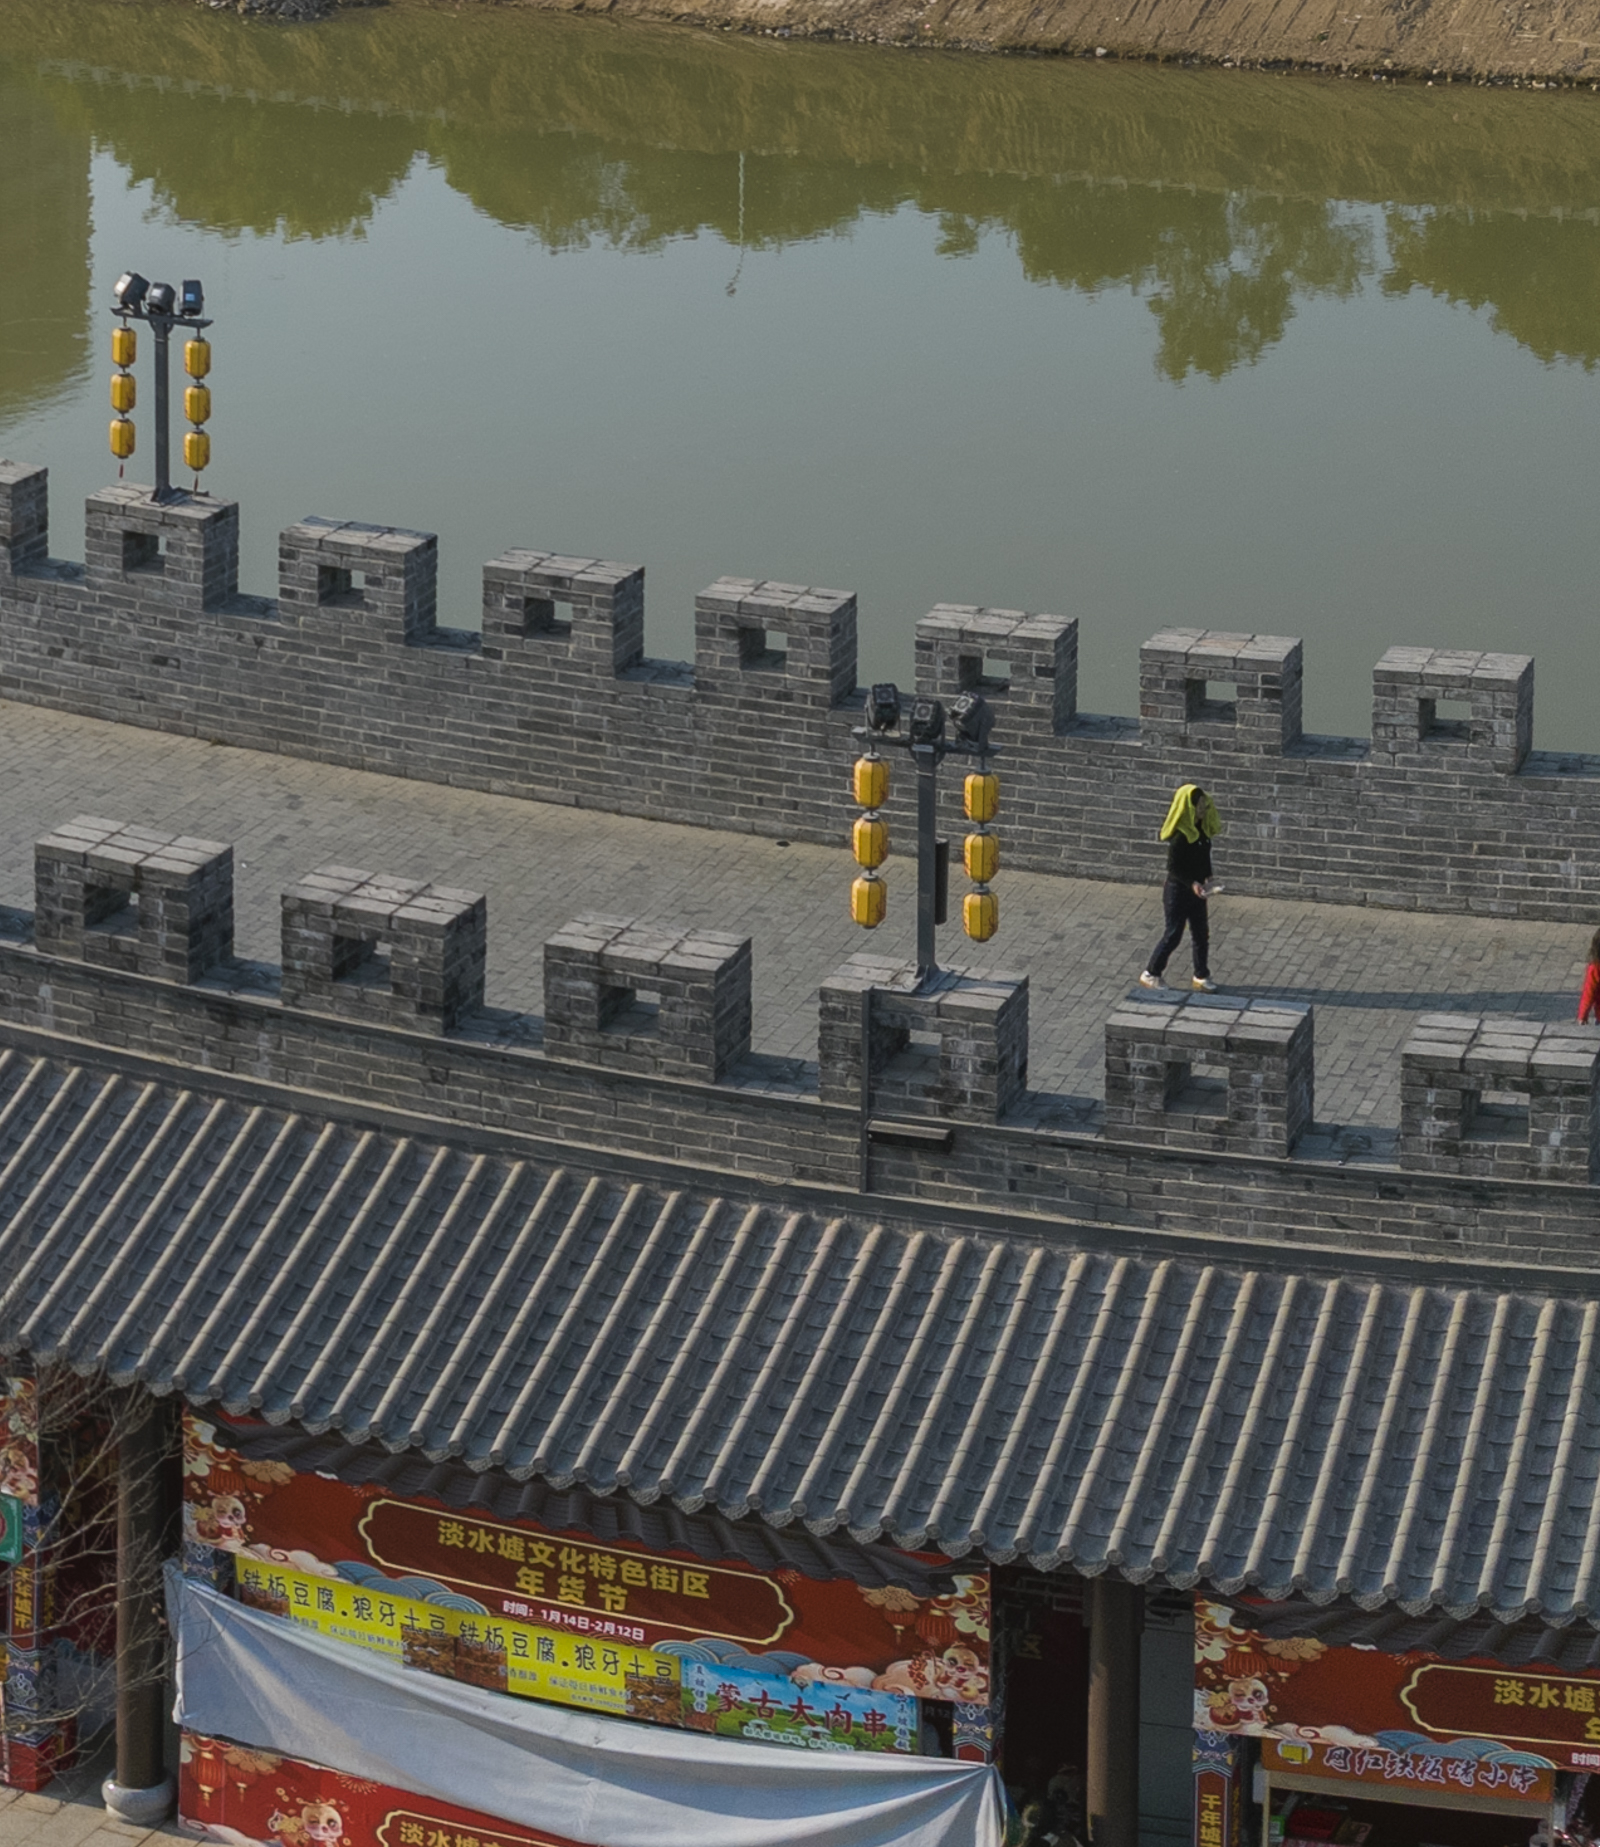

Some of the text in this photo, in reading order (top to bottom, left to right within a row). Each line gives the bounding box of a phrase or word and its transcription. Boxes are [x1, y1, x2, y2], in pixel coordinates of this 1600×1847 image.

[437, 1519, 710, 1600] 淡水墟文化特色街区
[515, 1565, 629, 1612] 年货节
[715, 1682, 888, 1739] 蒙古大肉串
[1493, 1678, 1600, 1714] 淡水墟
[1200, 1793, 1222, 1847] 千年墟
